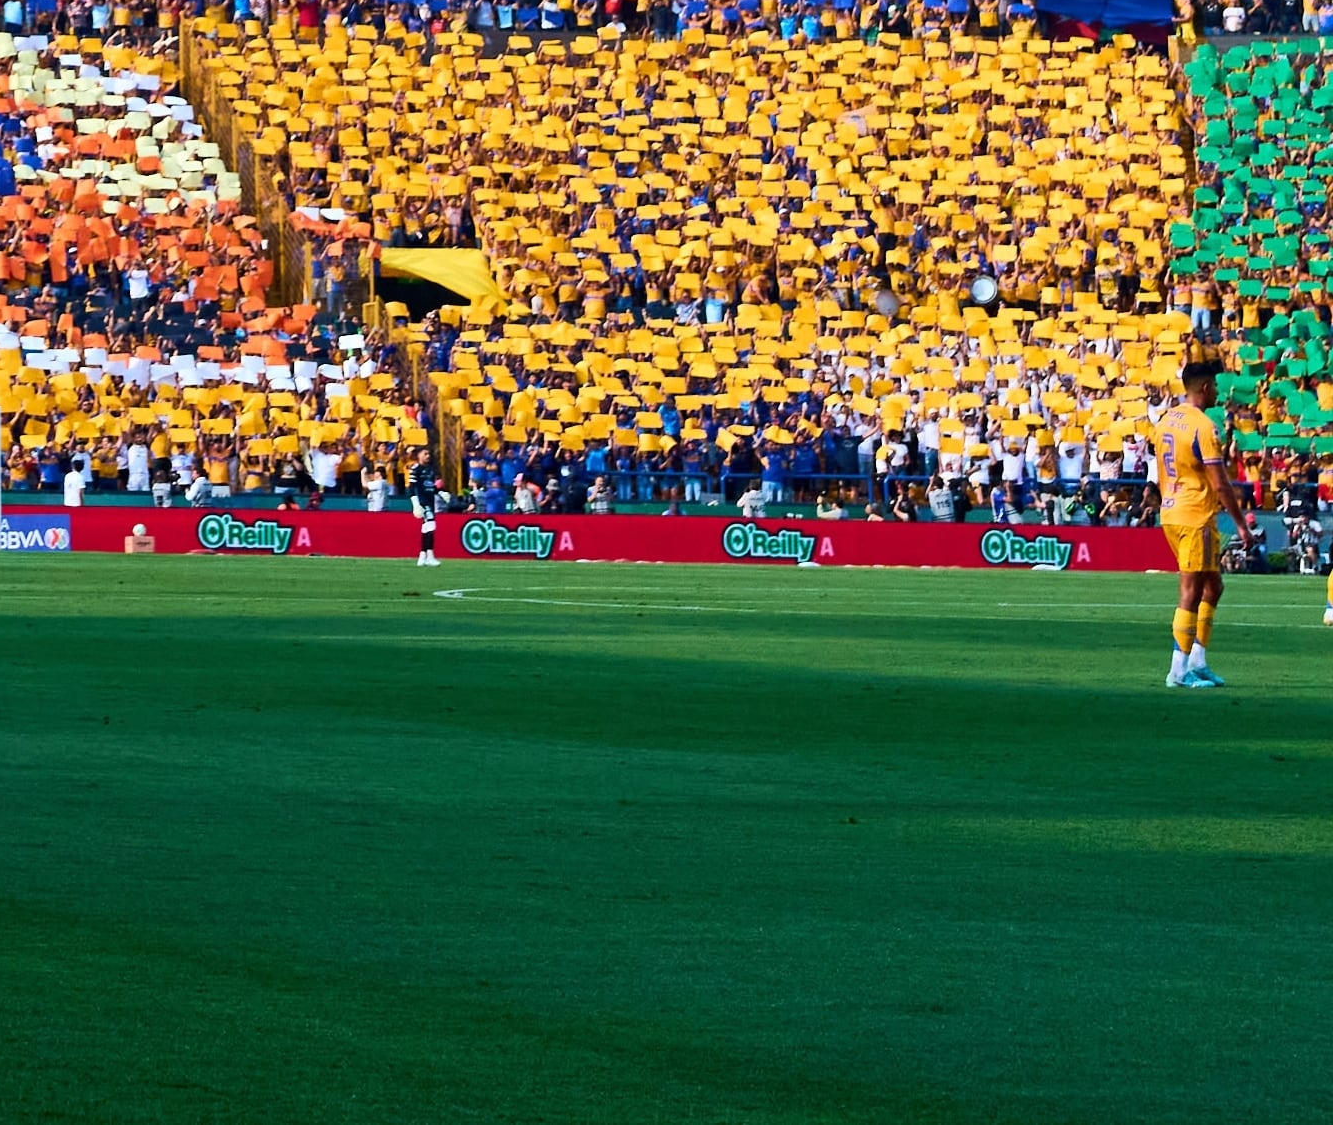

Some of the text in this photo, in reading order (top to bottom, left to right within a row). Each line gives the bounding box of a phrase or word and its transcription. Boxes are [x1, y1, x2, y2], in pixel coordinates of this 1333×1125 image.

[199, 514, 311, 553] O'Reilly A
[463, 520, 574, 559] O'Reilly A
[724, 523, 834, 562] O'Reilly A
[981, 530, 1091, 569] O'Reilly A
